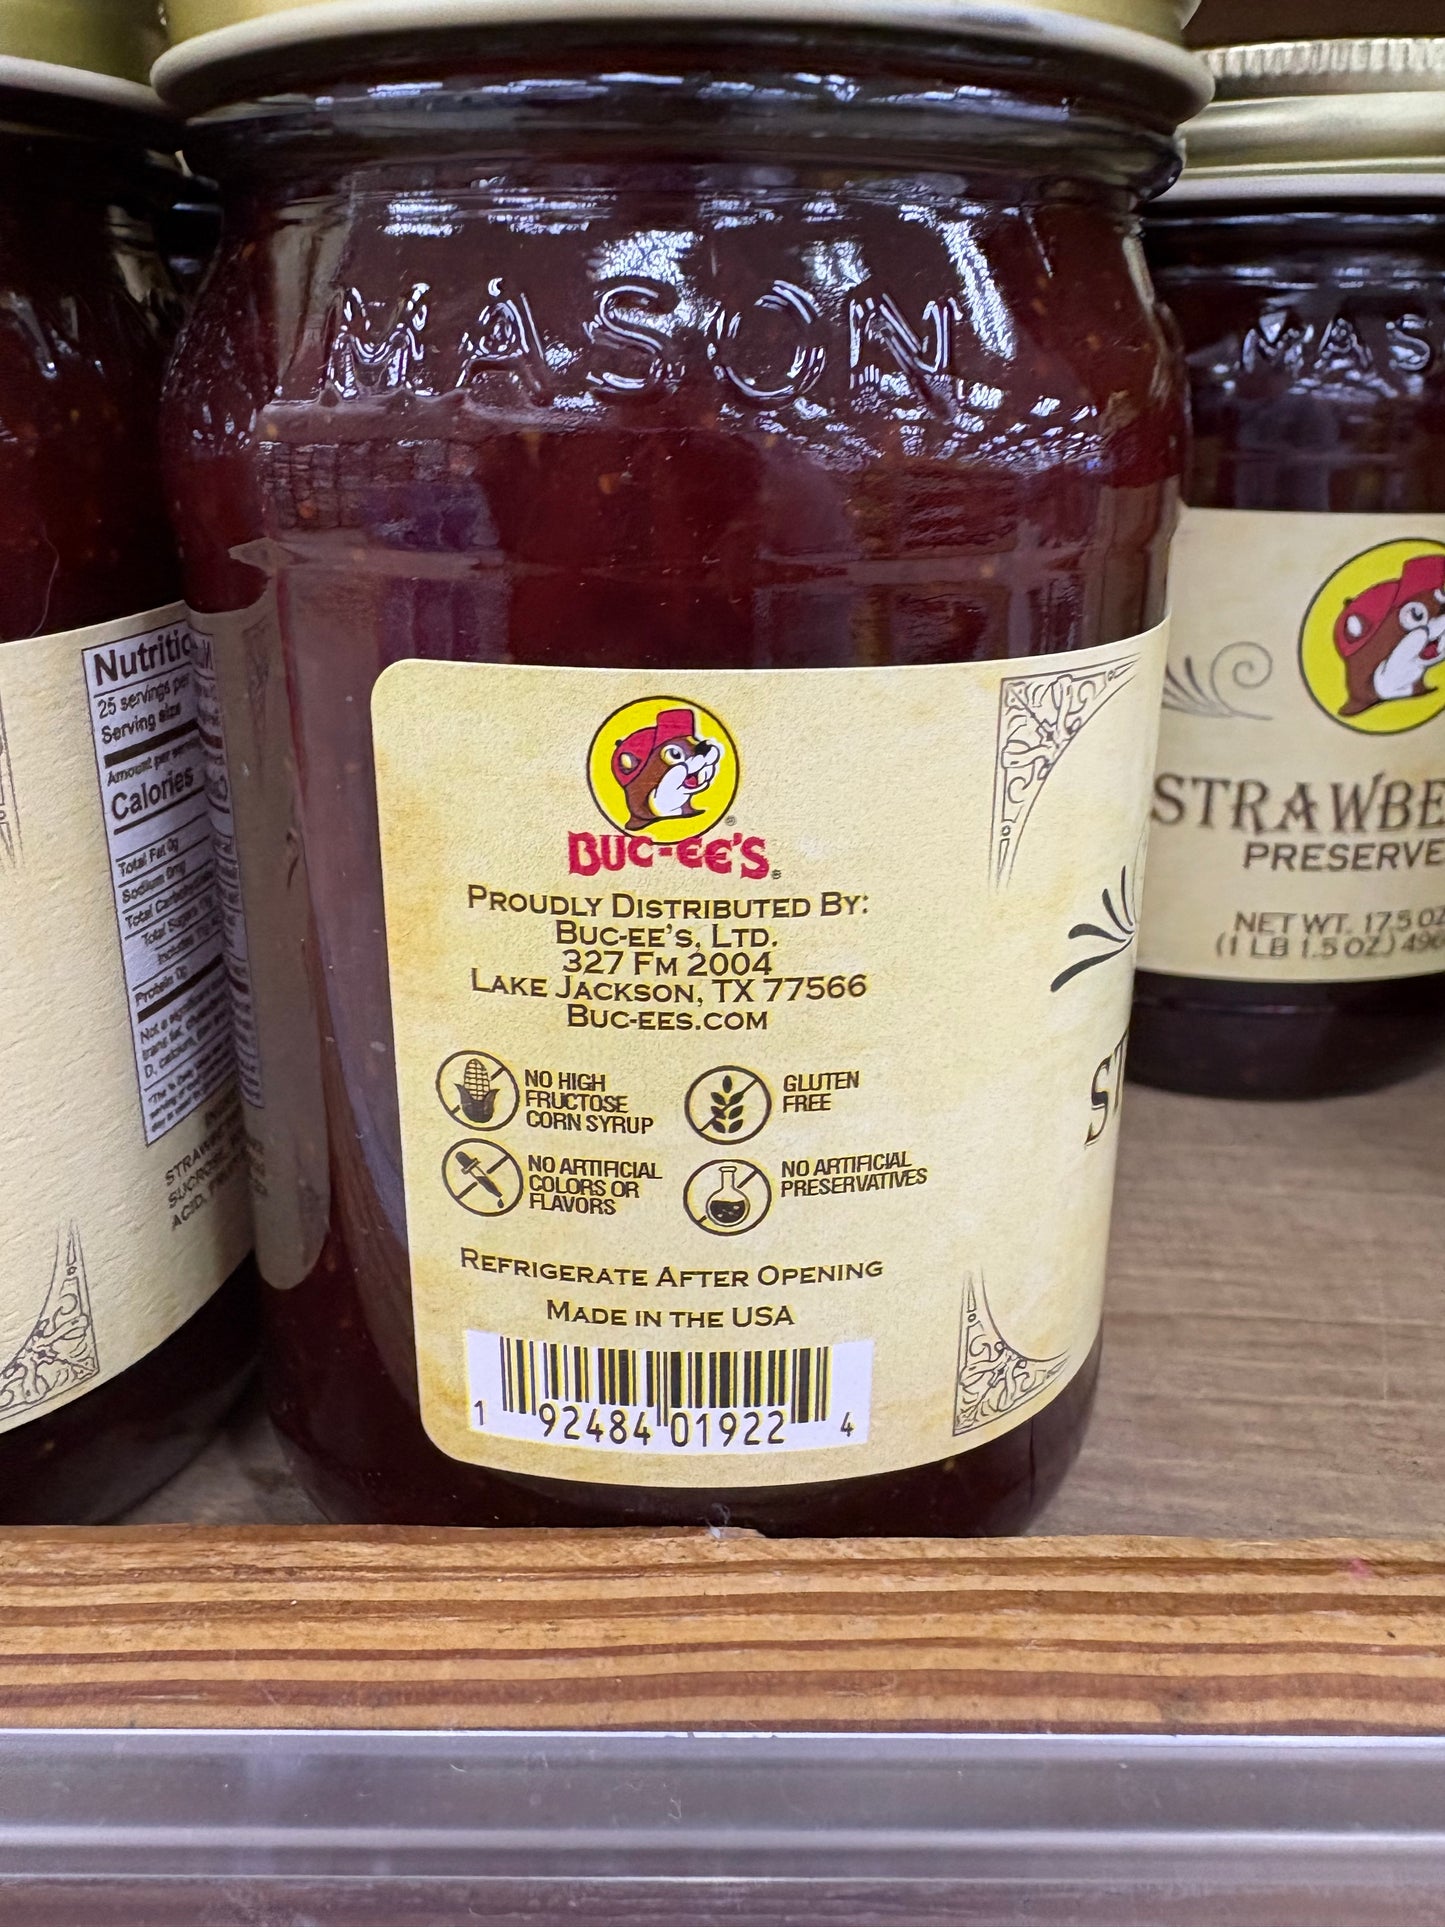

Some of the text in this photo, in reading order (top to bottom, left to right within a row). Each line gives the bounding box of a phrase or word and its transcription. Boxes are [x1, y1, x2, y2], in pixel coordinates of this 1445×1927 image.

[322, 278, 962, 405] MASON
[97, 697, 117, 719] 25
[101, 713, 157, 744] Serving
[112, 767, 194, 820] Calories
[118, 853, 148, 877] Total
[568, 831, 770, 880] BUC-EE'S
[125, 906, 154, 929] Total
[1234, 911, 1297, 935] NET
[141, 923, 166, 945] Total
[1251, 937, 1289, 958] LB
[562, 949, 624, 975] 327
[687, 951, 773, 977] 2004
[712, 977, 755, 1003] TX
[763, 974, 867, 1002] 77566
[525, 1069, 606, 1092] NO HIGH
[783, 1071, 860, 1092] GLUTEN
[525, 1091, 629, 1114] FRUCTOSE
[783, 1094, 832, 1114] FREE
[526, 1110, 654, 1135] CORN SYRUP
[528, 1155, 663, 1180] NO ARTIFICIAL
[782, 1151, 913, 1179] NO ARTIFICIAL
[529, 1175, 640, 1199] COLORS OR
[781, 1168, 928, 1198] PRESERVATIVES
[530, 1193, 616, 1216] FLAVORS
[732, 1305, 796, 1328] USA
[474, 1399, 855, 1447] 1 92484 01922 4
